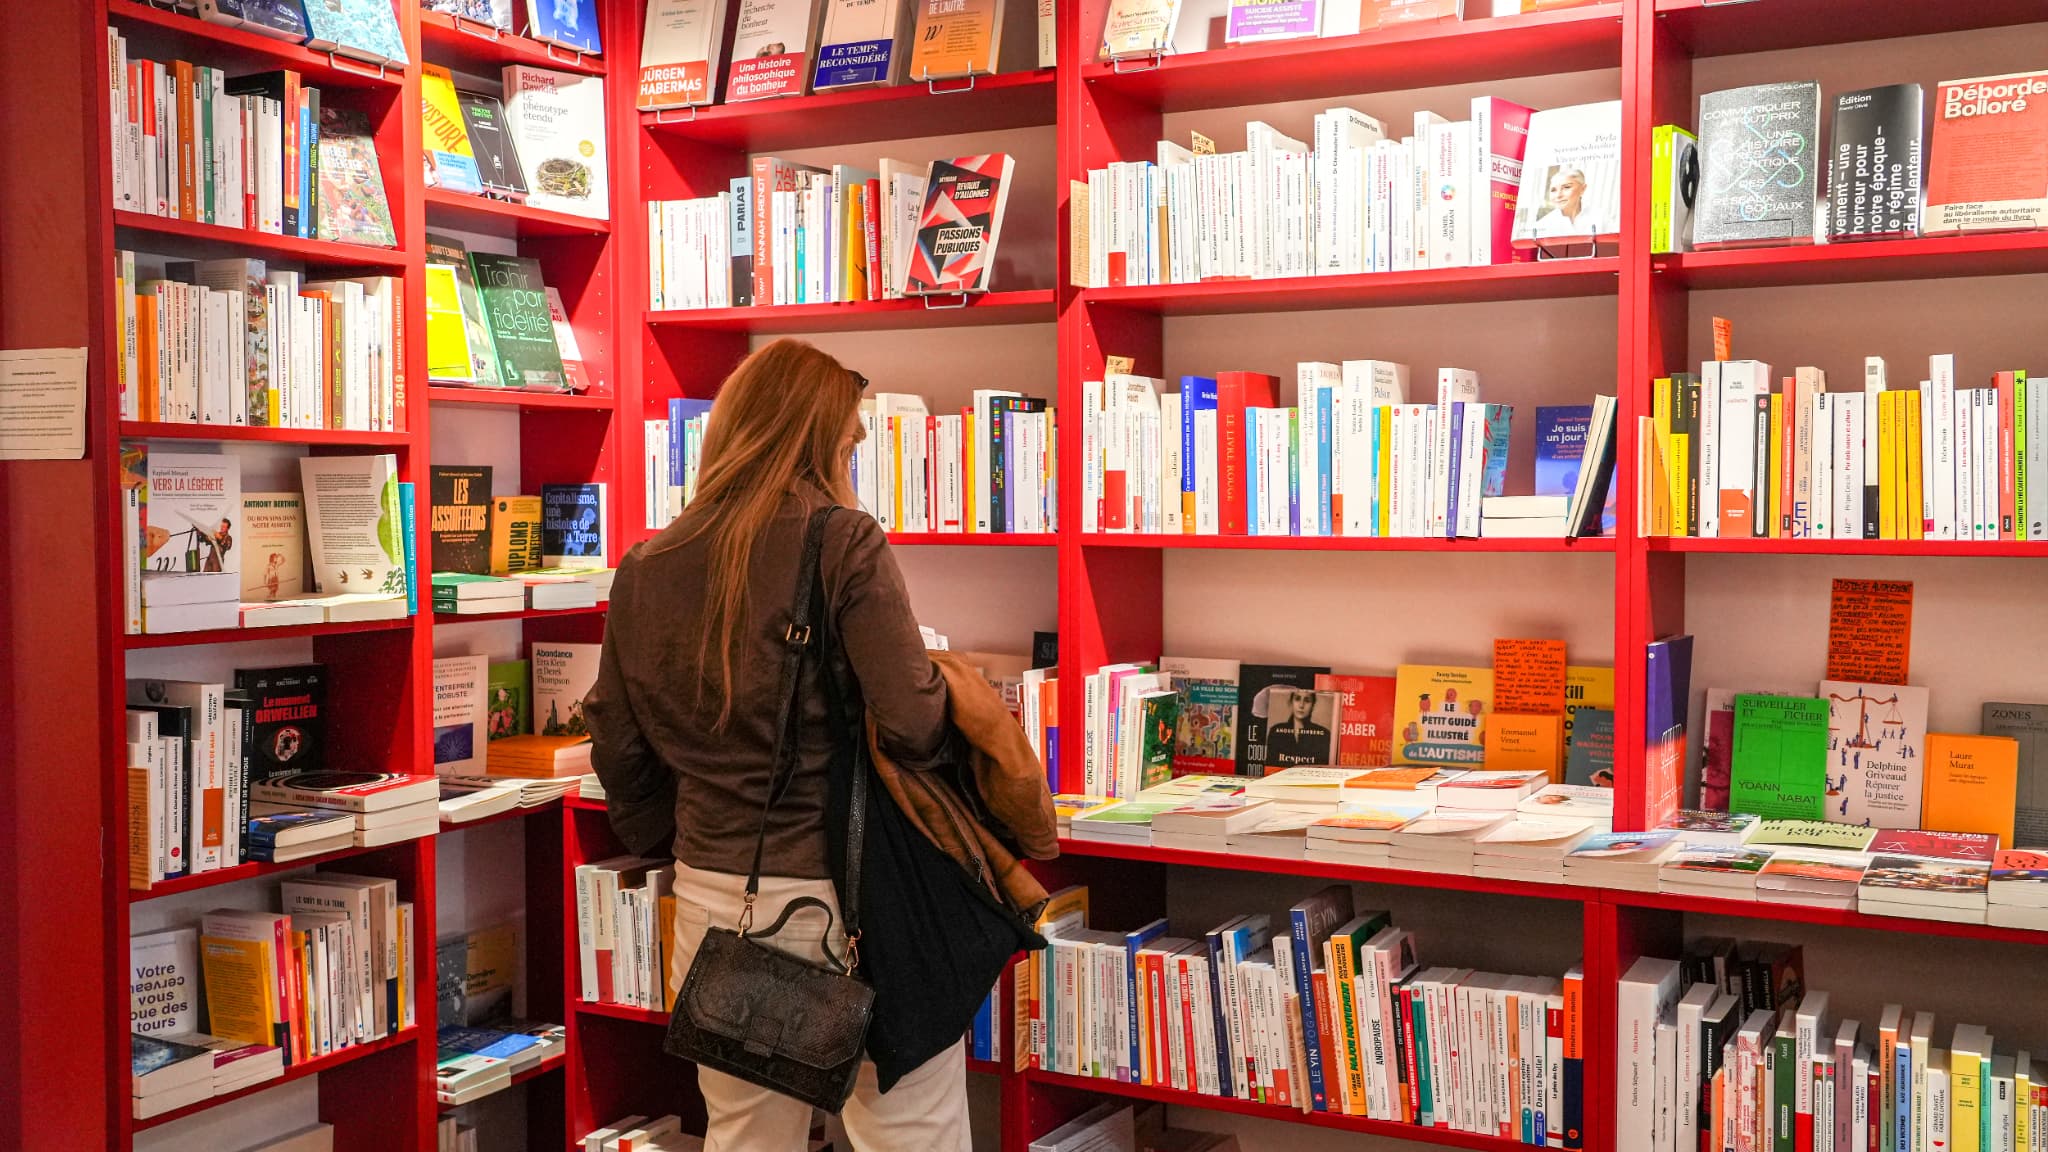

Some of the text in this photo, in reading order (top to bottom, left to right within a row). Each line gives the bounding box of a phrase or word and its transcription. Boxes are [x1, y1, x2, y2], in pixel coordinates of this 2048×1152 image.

[928, 0, 966, 14] DE L'AUTRE
[741, 18, 768, 30] bonheur
[832, 44, 878, 57] LE TEMPS
[739, 58, 792, 73] Une histoire
[820, 52, 888, 68] RECONSIDÉRÉ
[522, 72, 555, 86] Richard
[642, 66, 686, 82] JÜRGEN
[732, 68, 796, 85] philosophique
[522, 82, 558, 96] Dawkins
[640, 78, 702, 96] HABERMAS
[736, 80, 788, 96] du bonheur
[1840, 94, 1872, 106] Édition
[1944, 96, 2026, 118] Bolloré
[523, 100, 568, 116] phénotype
[523, 110, 554, 124] étendu
[1770, 111, 1801, 120] PRIX
[1766, 129, 1794, 139] UNE
[1840, 143, 1850, 169] une
[1856, 144, 1870, 178] pour
[1870, 136, 1889, 234] notre époque
[1886, 163, 1905, 232] le régime
[1904, 195, 1918, 208] la
[736, 186, 746, 232] PARIAS
[758, 178, 768, 266] HANNAH ARENDT
[1904, 213, 1916, 232] de
[939, 228, 981, 240] PASSIONS
[936, 241, 980, 254] PUBLIQUES
[480, 264, 529, 288] Trahir
[512, 288, 544, 310] par
[493, 308, 550, 334] fidélité
[395, 374, 404, 408] 2049
[1552, 424, 1586, 433] Je suis
[1547, 432, 1584, 444] un jour
[1226, 414, 1234, 502] LE LIVRE ROUGE
[152, 477, 224, 491] VERS LA LÉGÈRETÉ
[454, 478, 469, 504] LES
[545, 492, 598, 506] Capitalisme,
[432, 505, 486, 532] ASSOIFFEURS
[579, 518, 590, 529] de
[574, 532, 598, 543] Terre
[536, 649, 573, 657] Abondance
[550, 658, 566, 667] Klein
[544, 668, 562, 676] Derek
[436, 682, 474, 692] ENTREPRISE
[538, 676, 570, 686] Thompson
[264, 696, 274, 707] Le
[438, 691, 468, 700] ROBUSTE
[1444, 704, 1454, 712] LE
[1742, 700, 1806, 710] SURVEILLER
[256, 705, 317, 724] ORWELLIEN
[1422, 716, 1476, 727] PETIT GUIDE
[1784, 712, 1823, 720] FICHER
[1992, 710, 2031, 720] ZONES
[1248, 724, 1258, 742] LE
[1427, 729, 1468, 740] ILLUSTRÉ
[1501, 728, 1537, 736] Emmanuel
[1279, 754, 1315, 764] Respect
[1419, 746, 1485, 761] L'AUTISME
[1950, 751, 1973, 760] Laure
[1866, 761, 1907, 772] Delphine
[1949, 761, 1974, 770] Murat
[1866, 771, 1907, 781] Griveaud
[1738, 781, 1780, 792] YOANN
[1866, 781, 1900, 791] Réparer
[242, 789, 248, 798] DE
[1777, 794, 1818, 804] NABAT
[1864, 789, 1904, 802] la justice
[136, 964, 176, 979] Votre
[138, 992, 175, 1006] vous
[161, 1001, 188, 1015] des
[136, 1016, 176, 1033] tours
[1306, 1010, 1317, 1044] YOGA
[1340, 980, 1358, 1071] MAJOR MOUVEMENT
[1372, 1019, 1384, 1065] ANDROPAUSE
[1309, 1049, 1319, 1067] YIN
[1312, 1070, 1321, 1083] LE
